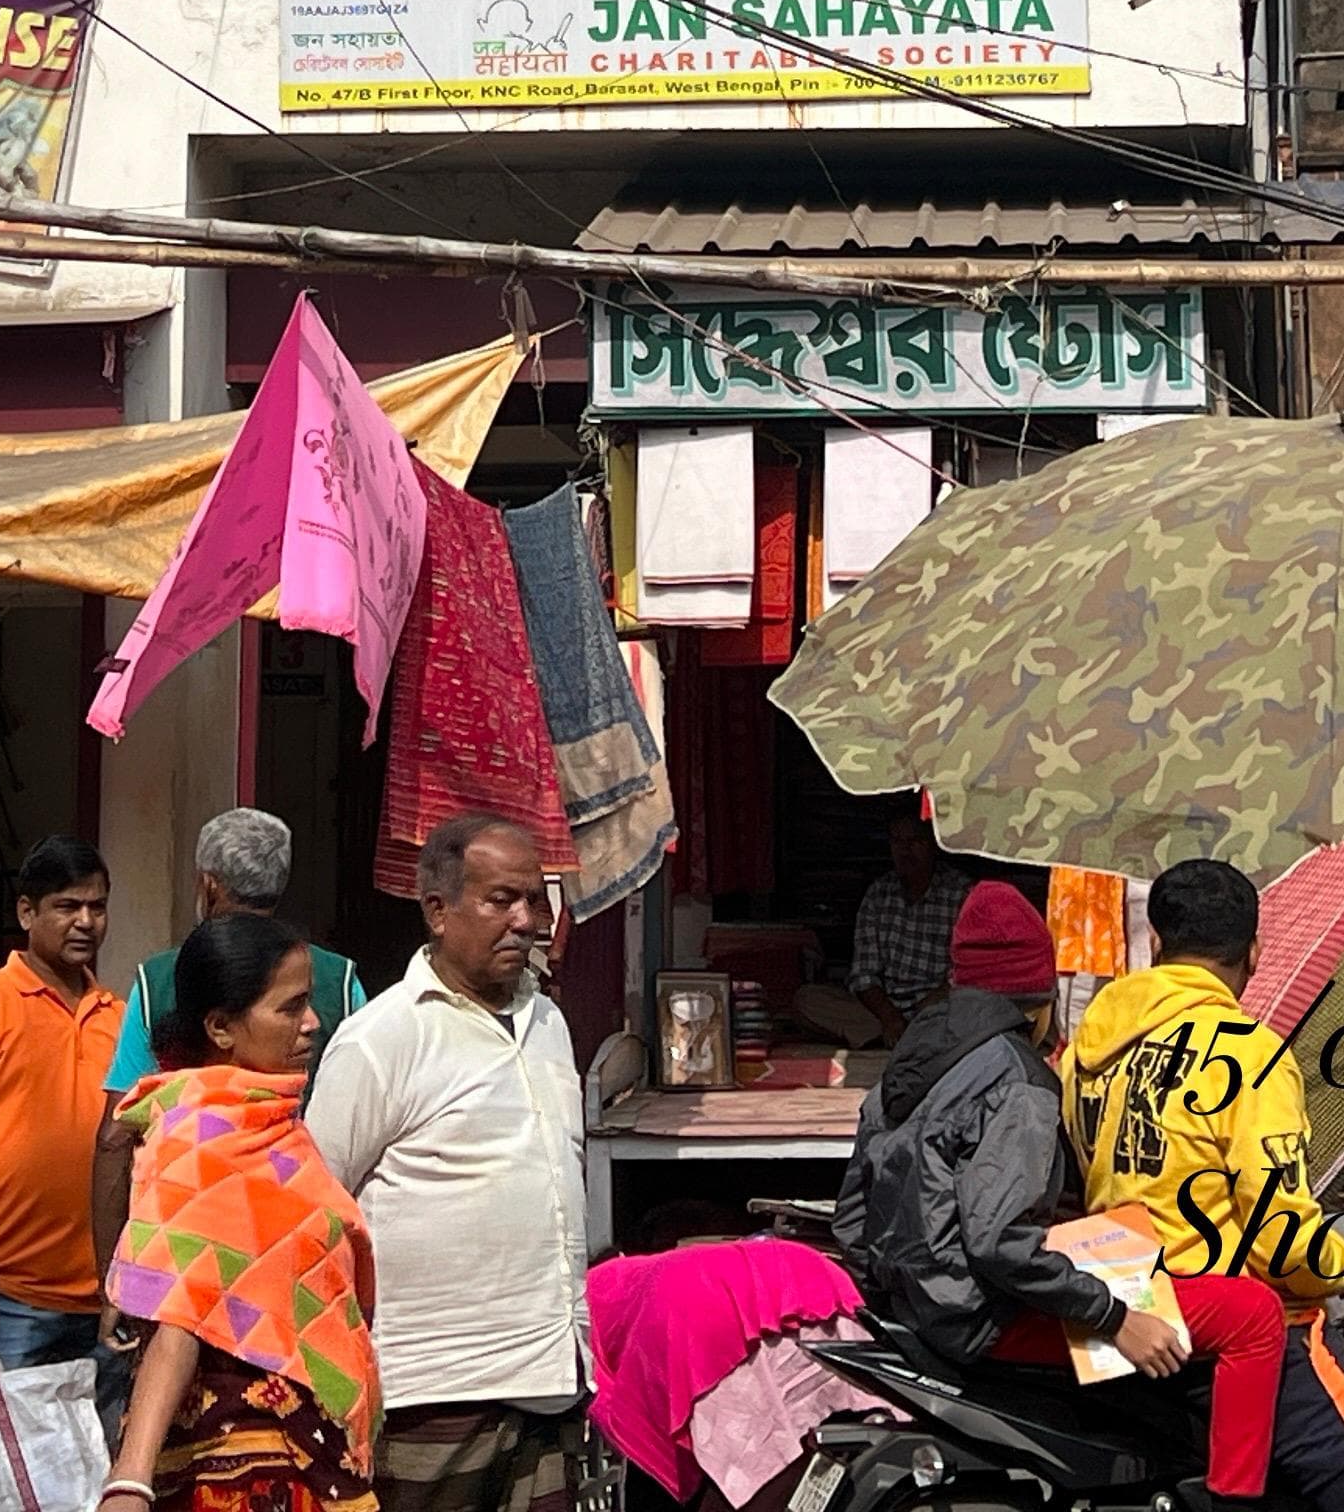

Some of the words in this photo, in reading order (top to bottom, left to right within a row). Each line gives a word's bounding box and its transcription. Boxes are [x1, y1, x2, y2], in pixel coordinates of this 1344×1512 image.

[291, 33, 325, 48] জন
[330, 31, 404, 50] সহায়তা
[590, 48, 851, 72] CHARITABLE
[877, 42, 1059, 67] SOCIETY
[377, 86, 419, 101] First
[424, 85, 474, 101] Floor,
[481, 84, 522, 98] KNC
[665, 80, 712, 94] West
[790, 78, 820, 92] Pin
